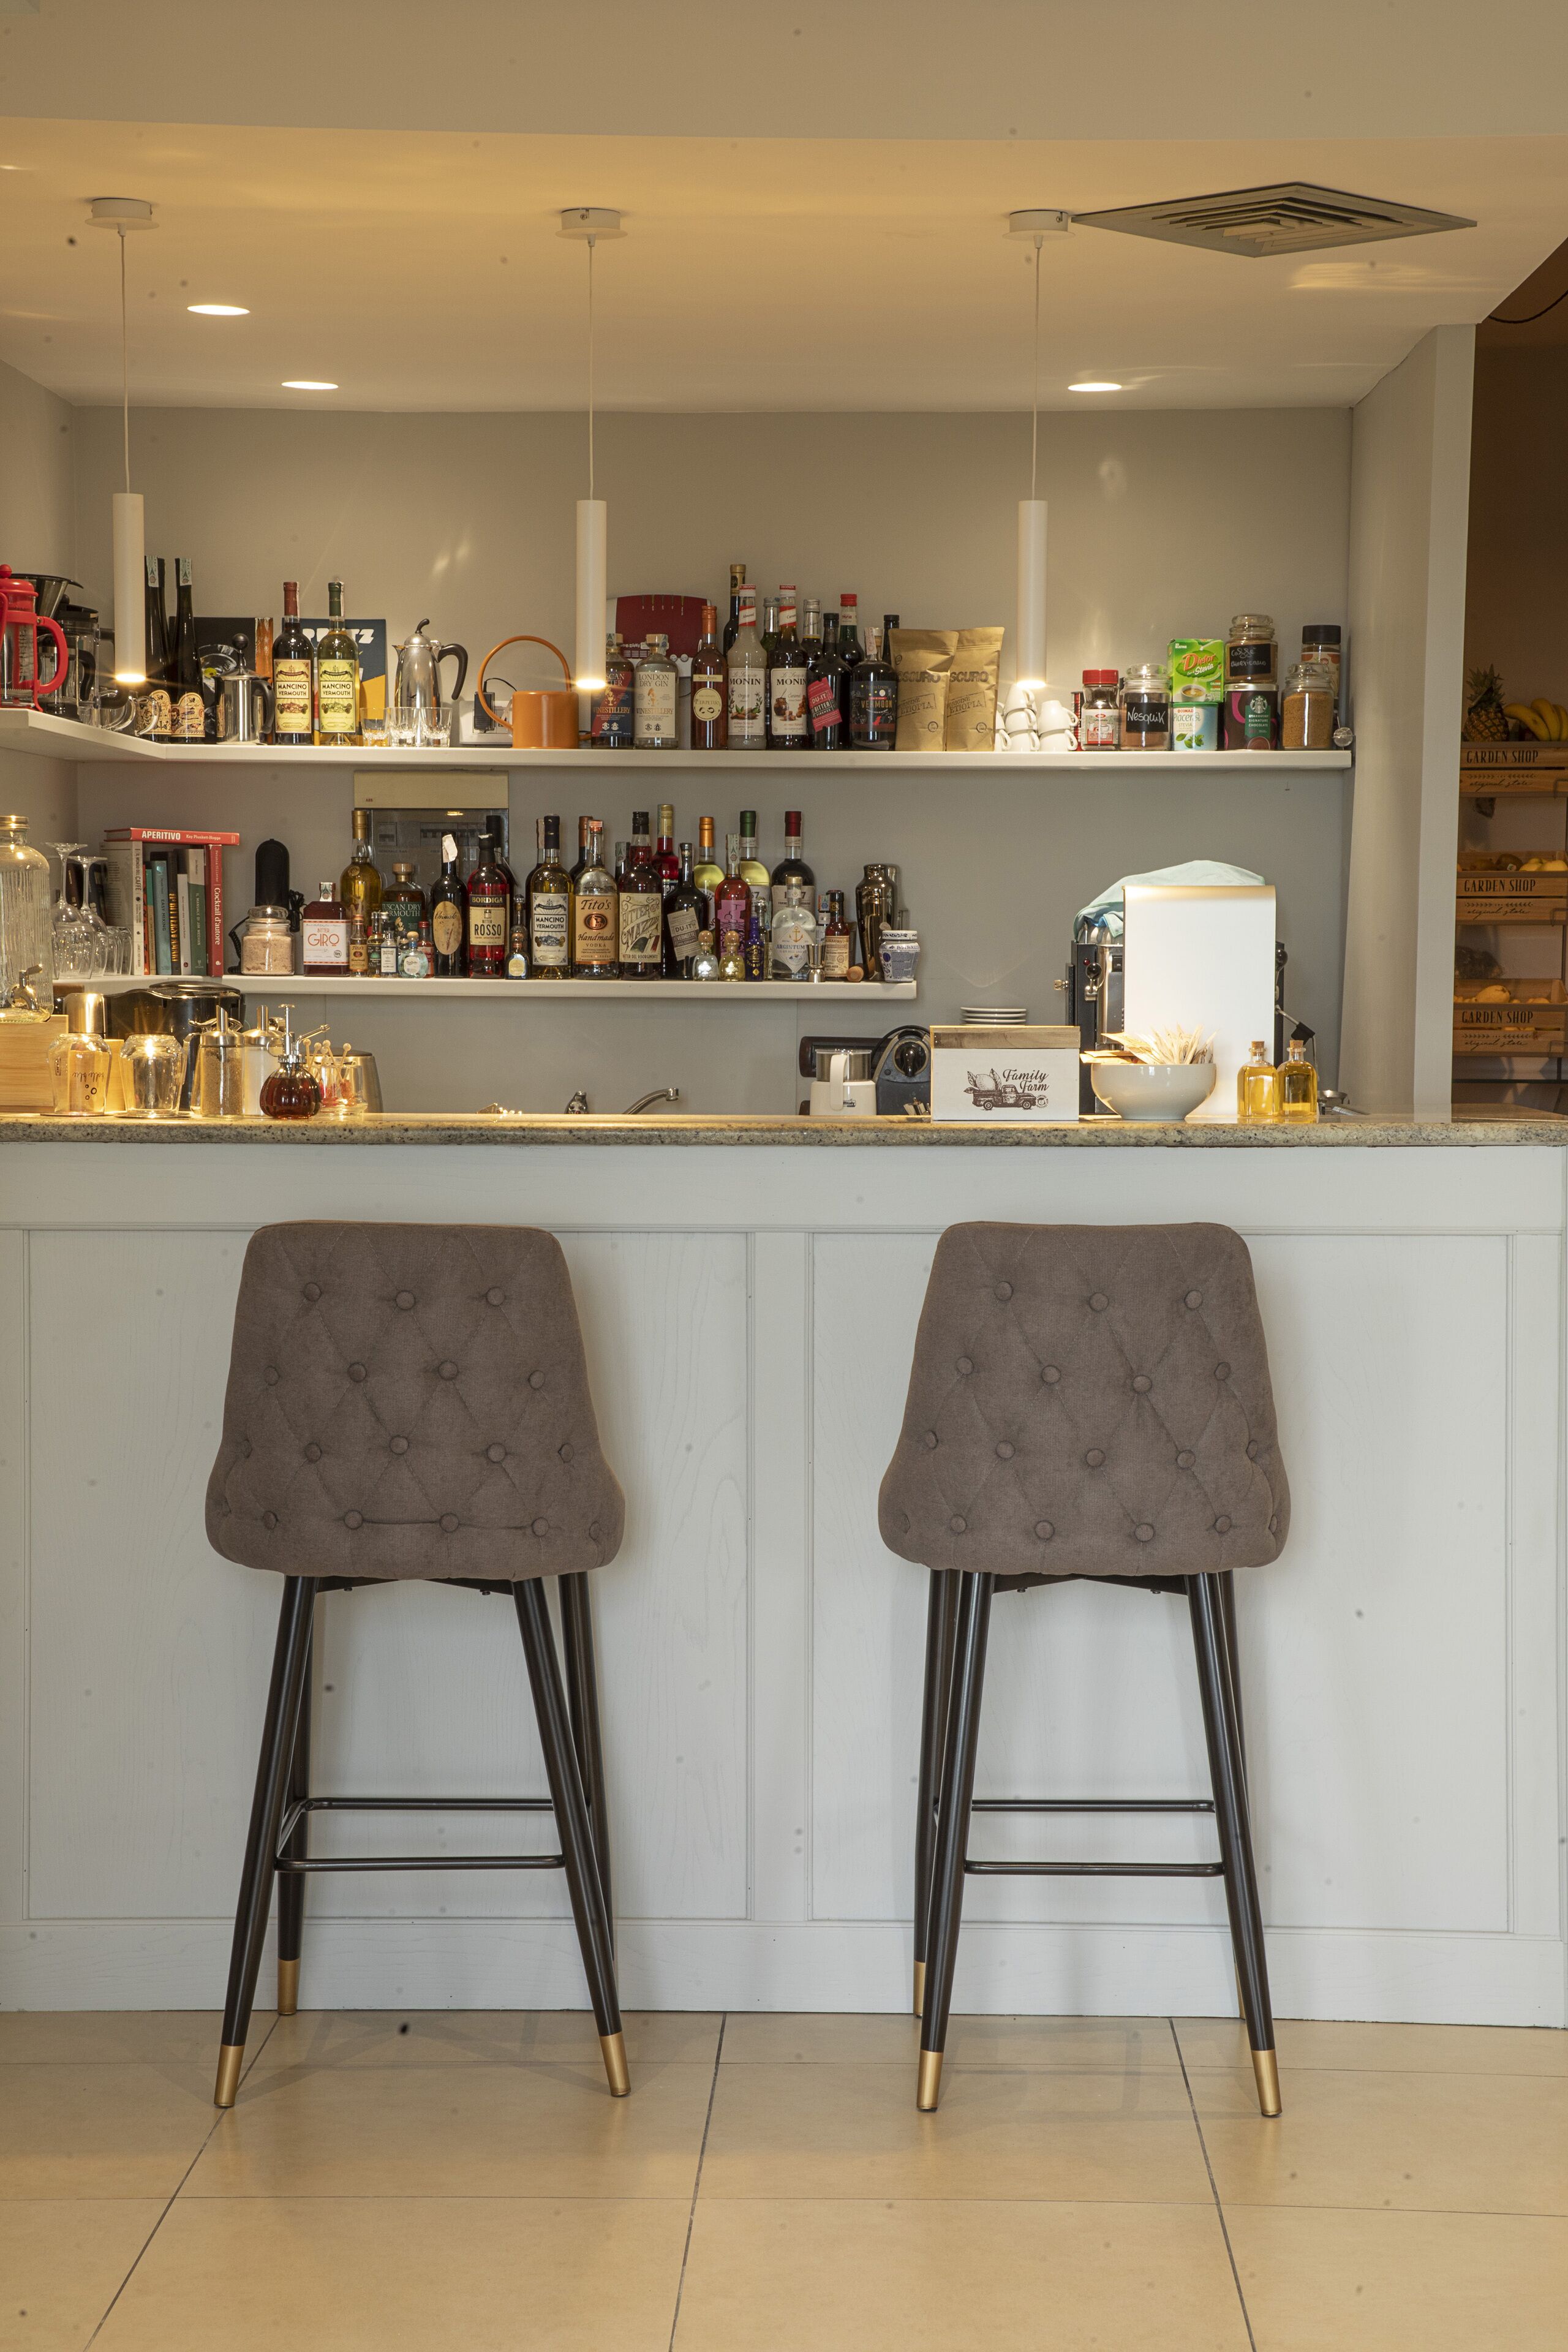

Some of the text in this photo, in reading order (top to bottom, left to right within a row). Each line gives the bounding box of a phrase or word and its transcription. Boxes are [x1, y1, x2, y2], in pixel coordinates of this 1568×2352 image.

[1183, 653, 1216, 671] Dietor
[1195, 663, 1213, 675] Stevia
[950, 671, 989, 682] SCURO
[814, 702, 830, 712] BITTER
[950, 700, 983, 713] ETIOPIA
[1467, 750, 1538, 763] GARDEN SHOP
[142, 831, 181, 840] APERITIVO
[1464, 879, 1536, 892] GARDEN SHOP
[474, 924, 502, 936] ROSSO
[308, 934, 340, 946] GIRO
[578, 932, 614, 941] Handmade
[1462, 1011, 1533, 1023] GARDEN SHOP
[1003, 1069, 1049, 1083] Family
[1020, 1080, 1050, 1093] Farm
